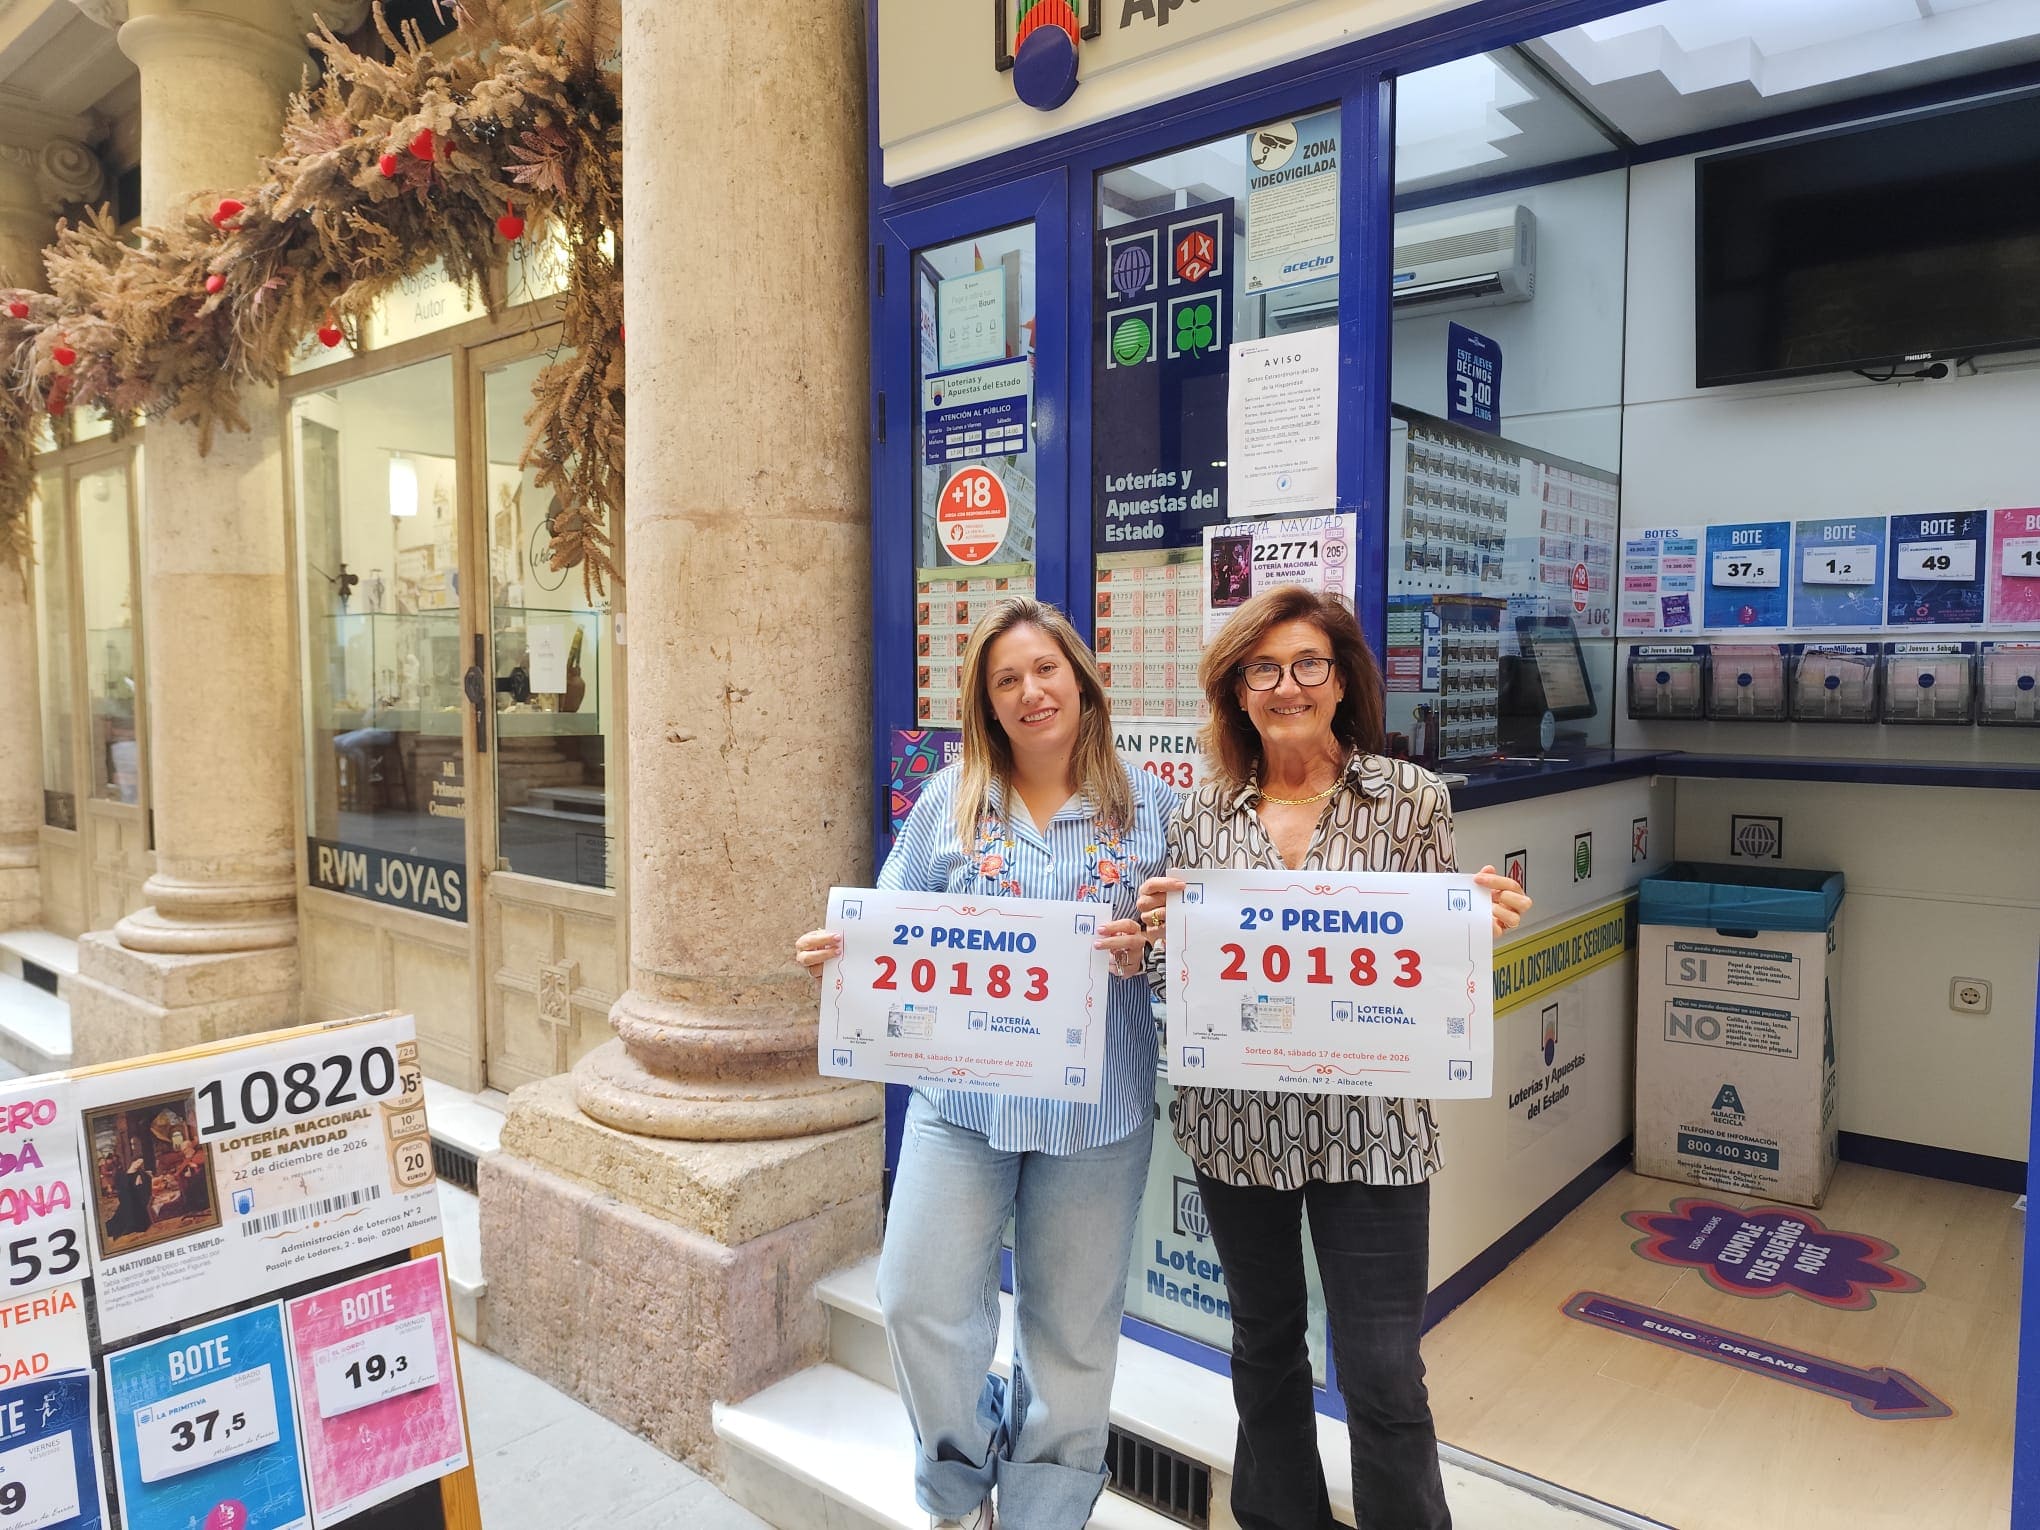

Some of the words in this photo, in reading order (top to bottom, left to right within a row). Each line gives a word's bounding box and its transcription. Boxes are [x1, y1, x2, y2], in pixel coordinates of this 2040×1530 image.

[1303, 138, 1336, 160] ZONA
[1250, 157, 1337, 190] VIDEOVIGILADA
[1283, 255, 1334, 274] acecho
[414, 296, 446, 323] Autor
[1904, 352, 1932, 361] PHILIPS
[948, 384, 981, 397] Apuestas
[982, 383, 995, 391] del
[995, 377, 1021, 389] Estado
[940, 411, 972, 422] ATENCIÓN
[983, 404, 1011, 415] PÚBLICO
[952, 477, 991, 508] +18
[1105, 468, 1176, 492] Loterías
[1181, 469, 1193, 490] y
[1106, 494, 1187, 521] Apuestas
[1190, 487, 1219, 510] del
[1105, 520, 1164, 541] Estado
[1280, 515, 1343, 533] NAVIDAD
[1644, 529, 1679, 539] BOTES
[1823, 525, 1857, 541] BOTE
[1920, 518, 1955, 536] BOTE
[1732, 529, 1762, 546] BOTE
[1253, 540, 1318, 562] 22771
[1922, 555, 1951, 571] 49
[1284, 561, 1318, 569] NACIONAL
[1728, 562, 1764, 578] 37,5
[1826, 559, 1852, 575] 1,2
[1587, 608, 1610, 625] 10€
[1115, 734, 1142, 752] AN
[1149, 735, 1203, 755] PREM
[318, 845, 368, 891] RVM
[374, 856, 462, 914] JOYAS
[1239, 907, 1273, 930] 2º
[1282, 908, 1404, 935] PREMIO
[892, 924, 923, 946] 2º
[930, 926, 1037, 954] PREMIO
[1219, 943, 1422, 989] 20183
[1492, 964, 1512, 1001] NGA
[1514, 963, 1526, 992] LA
[1527, 944, 1570, 986] DISTANCIA
[1571, 937, 1582, 964] DE
[1583, 917, 1623, 959] SEGURIDAD
[1680, 957, 1707, 982] SI
[871, 955, 1050, 1003] 20183
[990, 1014, 1031, 1026] LOTERÍA
[1357, 1004, 1404, 1016] LOTERÍA
[1357, 1013, 1417, 1025] NACIONAL
[990, 1023, 1041, 1036] NACIONAL
[1670, 1012, 1721, 1041] NO
[889, 1050, 913, 1058] Sorteo
[914, 1052, 926, 1060] 84,
[926, 1053, 952, 1062] sábado
[976, 1057, 1003, 1066] octubre
[1245, 1047, 1272, 1055] Sorteo
[1273, 1048, 1286, 1057] 84,
[1287, 1049, 1317, 1058] sábado
[1330, 1051, 1341, 1059] de
[1343, 1052, 1375, 1060] octubre
[1376, 1053, 1387, 1061] de
[1389, 1054, 1410, 1062] 2026
[197, 1046, 395, 1136] 10820
[969, 1079, 1000, 1087] Albacete
[1278, 1074, 1308, 1083] Admón.
[1337, 1078, 1373, 1087] Albacete
[1508, 1078, 1543, 1110] Loterías
[1545, 1072, 1550, 1088] y
[1551, 1053, 1586, 1082] Apuestas
[1527, 1099, 1541, 1121] del
[1543, 1083, 1570, 1111] Estado
[1711, 1111, 1746, 1121] ALBACETE
[1713, 1117, 1743, 1127] RECICLA
[220, 1126, 290, 1153] LOTERÍA
[294, 1107, 372, 1135] NACIONAL
[1716, 1130, 1726, 1138] DE
[251, 1147, 274, 1162] DE
[278, 1129, 348, 1155] NAVIDAD
[1687, 1139, 1712, 1153] 800
[1715, 1144, 1740, 1158] 400
[1743, 1149, 1768, 1163] 303
[234, 1169, 248, 1181] 22
[251, 1163, 266, 1176] de
[268, 1149, 322, 1172] diciembre
[327, 1144, 341, 1158] de
[342, 1138, 368, 1154] 2026
[404, 1153, 425, 1173] 20
[407, 1171, 427, 1182] EUROS
[281, 1226, 351, 1255] Administración
[353, 1223, 364, 1233] de
[416, 1206, 422, 1215] 2
[1688, 1235, 1705, 1250] EURO
[1701, 1215, 1723, 1235] DREAMS
[1761, 1219, 1806, 1262] SUEÑOS
[265, 1257, 293, 1273] Pasaje
[294, 1252, 305, 1262] de
[308, 1245, 344, 1259] Lodares,
[345, 1240, 350, 1249] 2
[381, 1224, 405, 1237] 02001
[406, 1215, 438, 1229] Albacete
[1717, 1222, 1766, 1265] CUMPLE
[8, 1228, 81, 1287] 53
[119, 1253, 163, 1273] NATIVIDAD
[164, 1249, 175, 1260] EN
[177, 1246, 187, 1257] EL
[1155, 1239, 1225, 1285] Loter
[1793, 1241, 1831, 1275] AQUÍ
[1745, 1258, 1780, 1283] TUS
[341, 1283, 395, 1328] BOTE
[1147, 1269, 1231, 1322] Nacion
[0, 1289, 78, 1330] TERÍA
[395, 1316, 426, 1331] DOMINGO
[168, 1335, 232, 1382] BOTE
[1641, 1319, 1697, 1341] EURO
[1718, 1342, 1808, 1374] DREAMS
[0, 1351, 49, 1385] DAD
[345, 1353, 408, 1389] 19,3
[0, 1400, 26, 1432] TE
[156, 1409, 167, 1420] LA
[168, 1398, 207, 1416] PRIMITIVA
[170, 1409, 246, 1453] 37,5
[28, 1439, 61, 1456] VIERNES
[0, 1481, 27, 1516] 9
